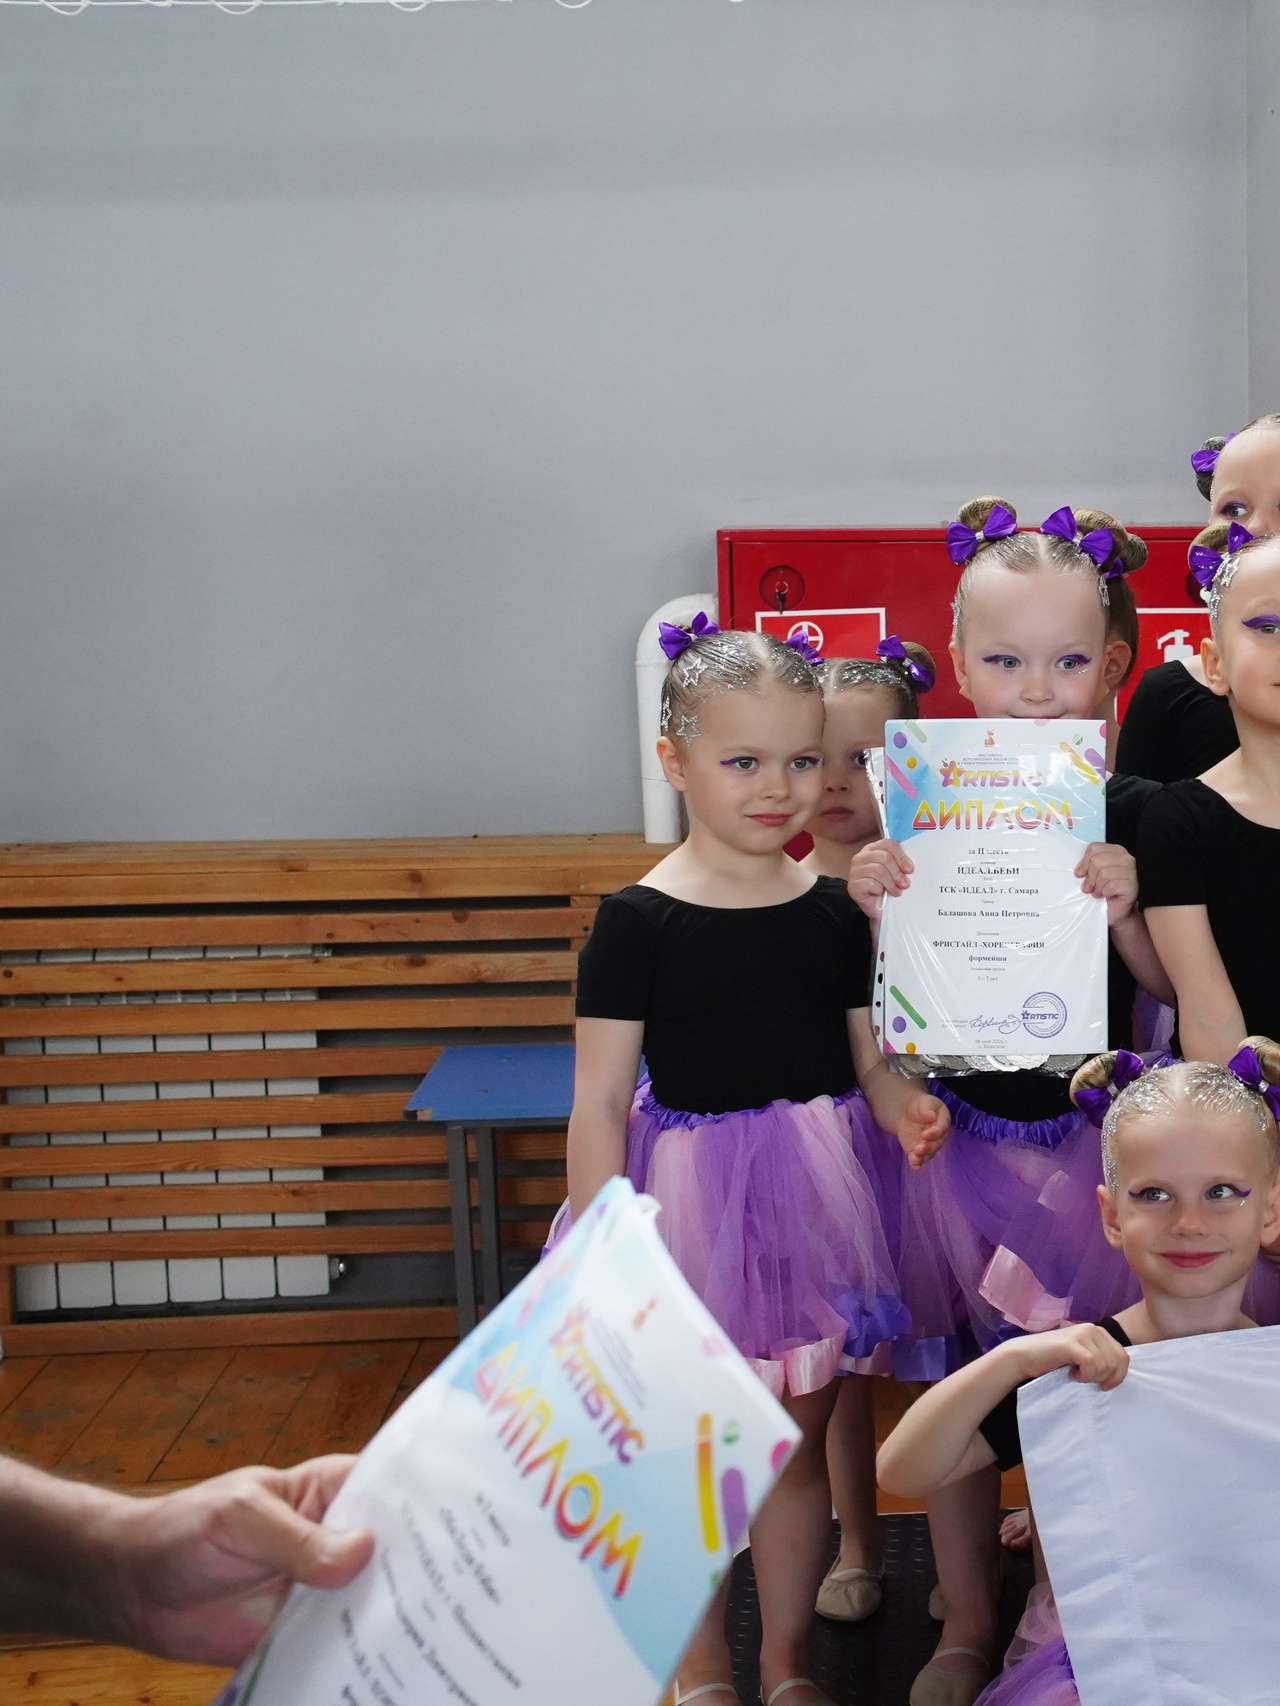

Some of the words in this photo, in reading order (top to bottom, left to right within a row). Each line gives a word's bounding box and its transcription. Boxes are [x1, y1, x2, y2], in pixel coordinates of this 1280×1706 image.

[912, 799, 1075, 830] ДИПЛОМ
[939, 886, 957, 894] ТСК
[1008, 887, 1039, 896] Самара
[938, 908, 977, 917] Балашова
[979, 910, 1000, 918] Анна
[1001, 910, 1040, 919] Петровна
[932, 940, 978, 949] ФРИСТАЙЛ
[968, 954, 1008, 963] формейшн
[1021, 1010, 1060, 1020] ARTISTIC
[471, 1342, 644, 1600] ДИПЛОМ
